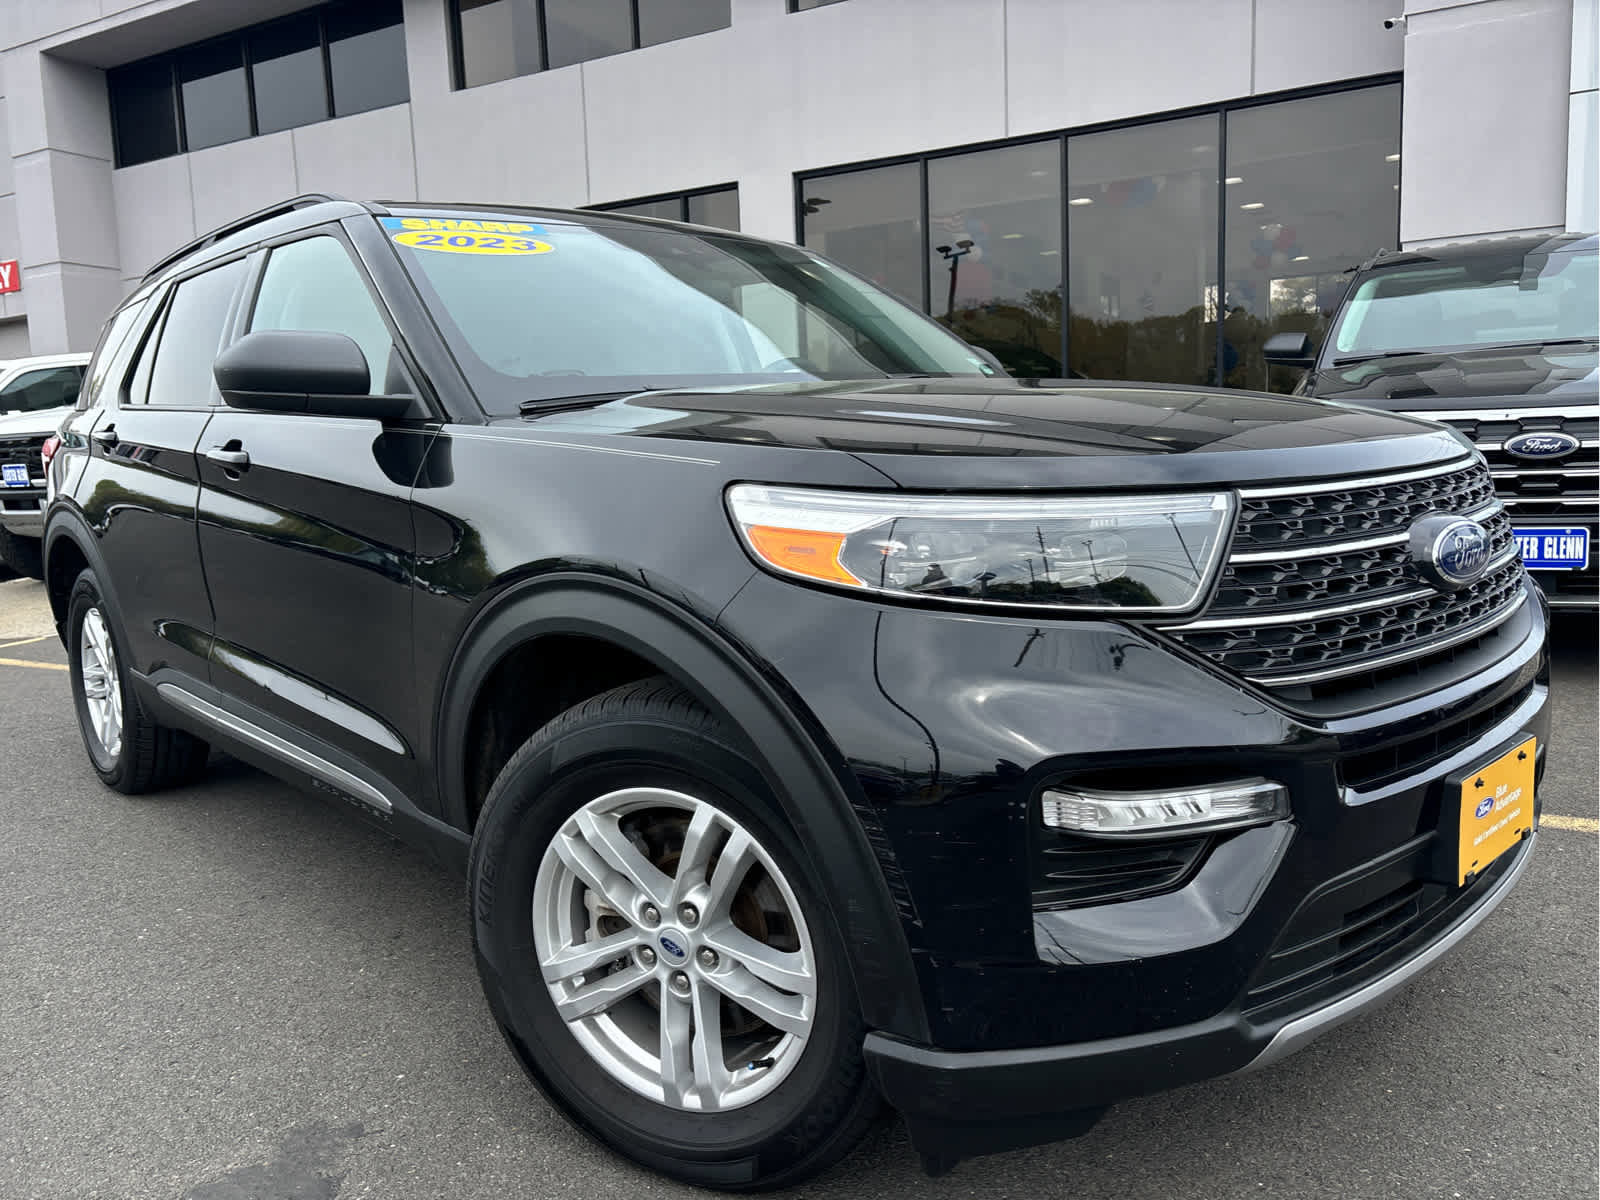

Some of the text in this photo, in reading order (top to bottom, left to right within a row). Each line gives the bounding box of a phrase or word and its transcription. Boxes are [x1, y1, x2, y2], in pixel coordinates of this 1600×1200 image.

[400, 218, 534, 234] SHARP
[415, 234, 538, 251] 2023
[0, 264, 11, 289] Y
[1521, 438, 1563, 453] Ford
[1513, 536, 1584, 560] TER GLENN
